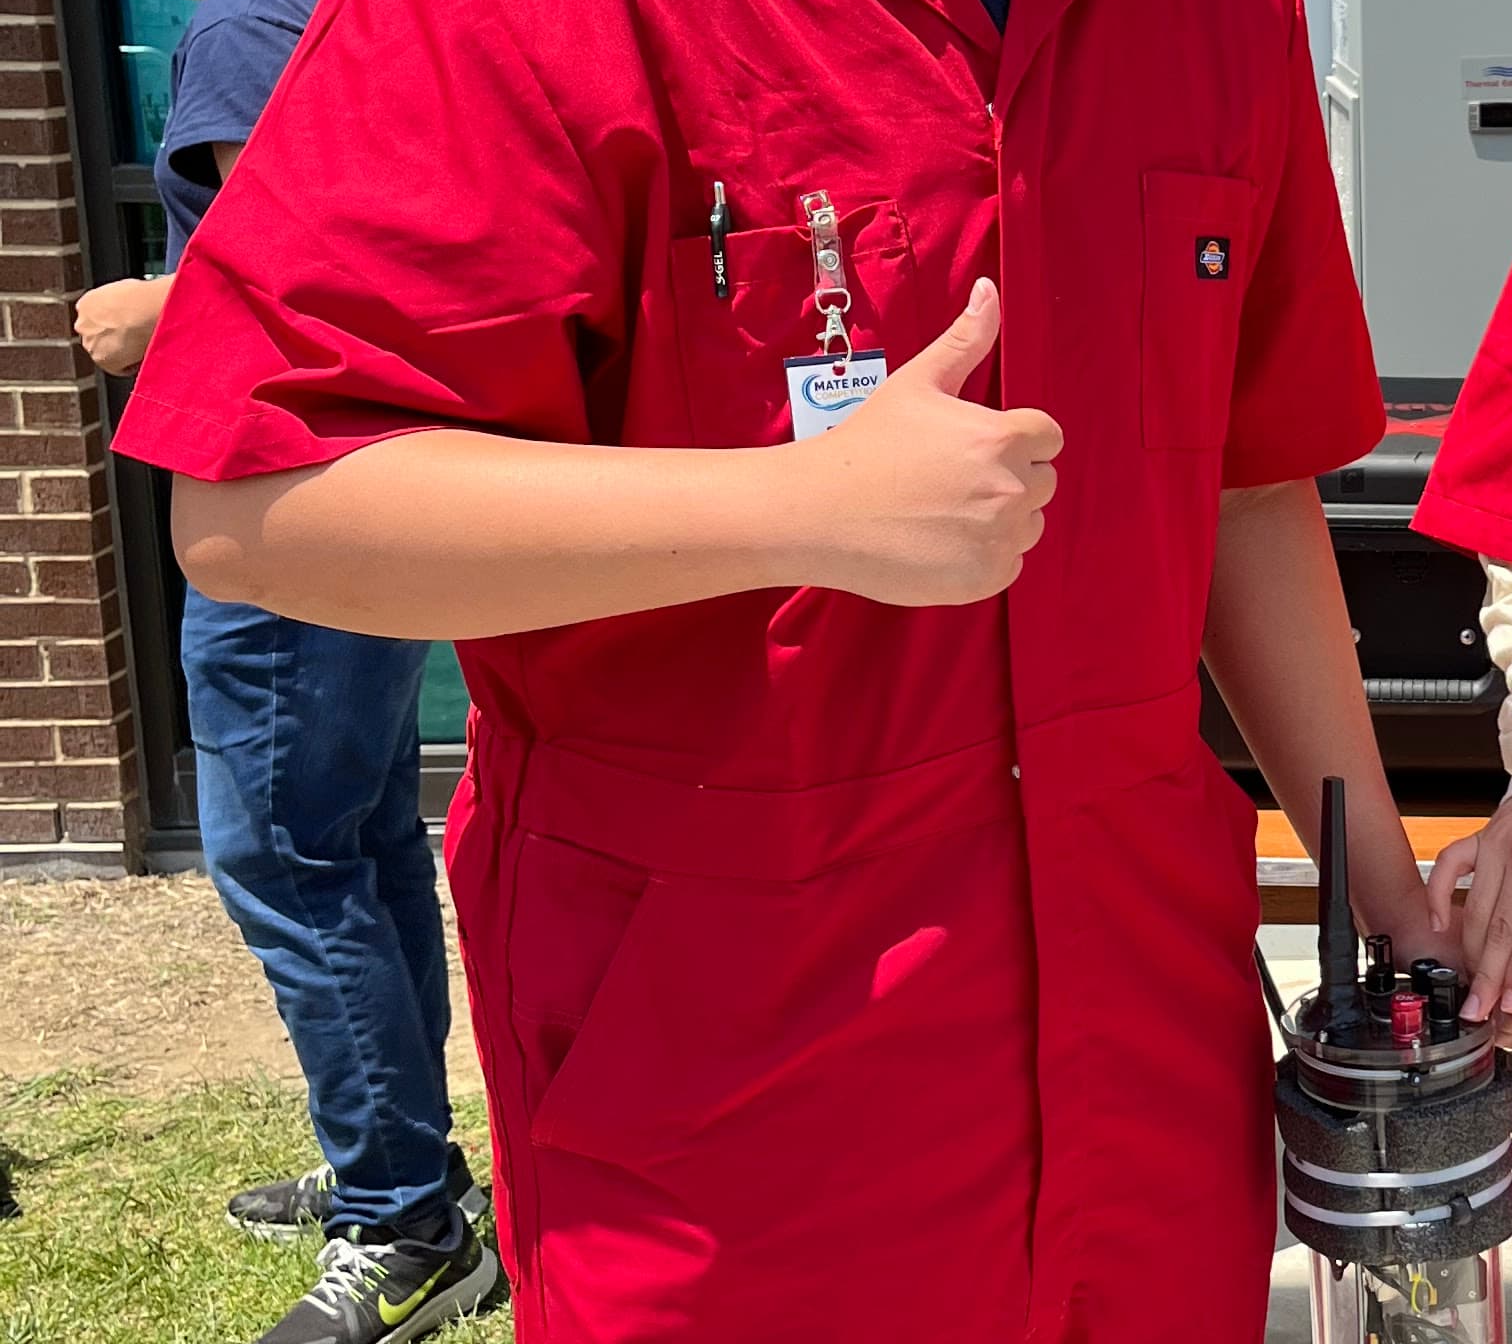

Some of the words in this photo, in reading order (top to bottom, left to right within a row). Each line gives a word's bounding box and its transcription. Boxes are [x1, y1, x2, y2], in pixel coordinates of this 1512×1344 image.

[1465, 80, 1499, 88] Thermal
[814, 378, 849, 392] MATE
[852, 375, 878, 388] ROV
